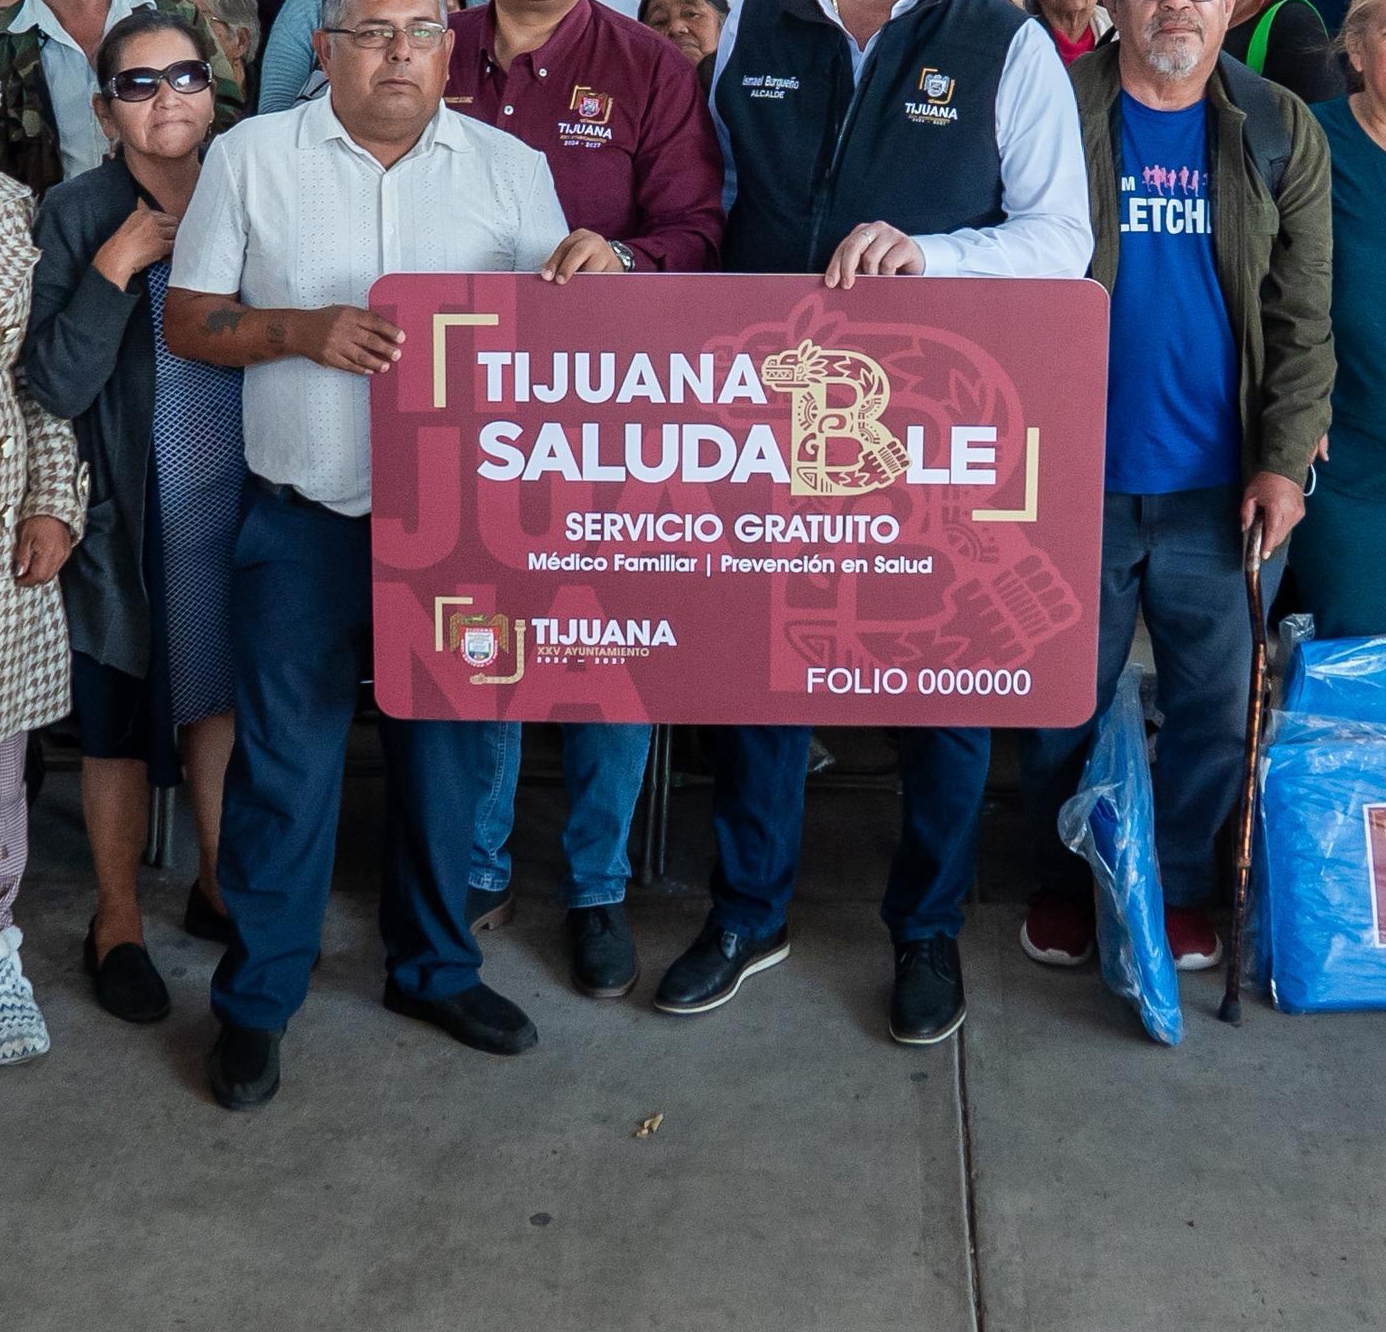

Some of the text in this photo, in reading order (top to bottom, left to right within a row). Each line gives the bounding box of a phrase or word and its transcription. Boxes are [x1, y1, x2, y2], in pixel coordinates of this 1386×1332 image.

[742, 74, 799, 90] Ismael Burgueño
[750, 88, 785, 99] ALCALDE
[905, 102, 958, 120] TIJUANA
[558, 122, 612, 140] TIJUANA
[477, 351, 767, 404] TIJUANA
[477, 360, 999, 496] SALUDABLE
[565, 512, 899, 545] SERVICIO GRATUITO
[527, 550, 933, 574] Médico Familiar Prevención en Salud
[531, 618, 678, 646] TIJUANA
[537, 647, 650, 657] XXV AYUNTAMIENTO
[806, 668, 1032, 696] FOLIO 000000
